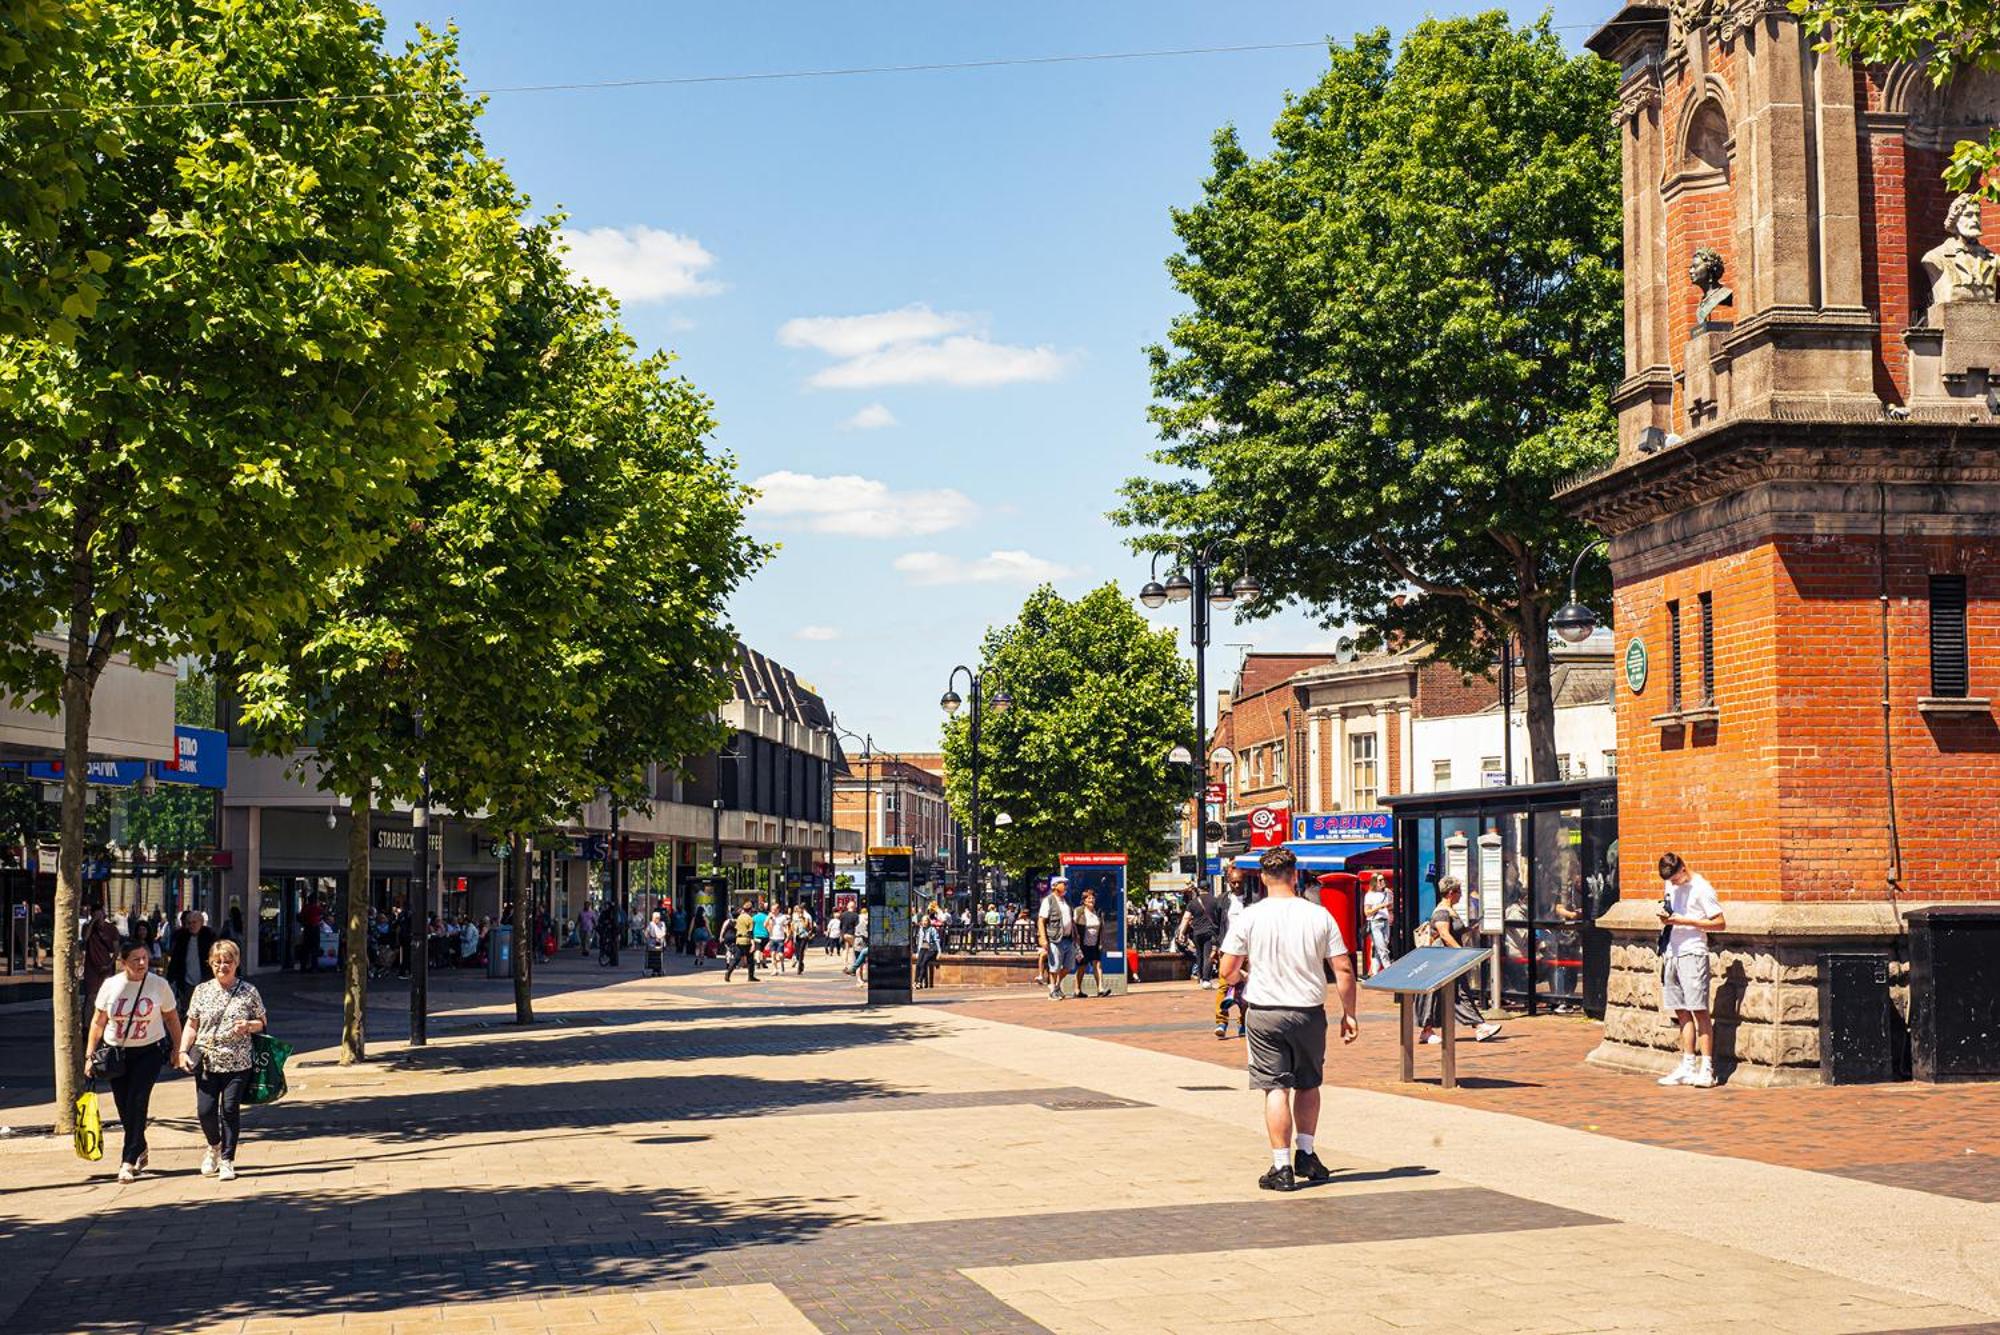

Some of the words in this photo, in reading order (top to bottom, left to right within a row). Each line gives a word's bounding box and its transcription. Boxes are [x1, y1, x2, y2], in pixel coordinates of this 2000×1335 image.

[178, 759, 197, 773] BANK
[1313, 815, 1387, 831] SABINA
[378, 830, 416, 849] STARBUCK
[428, 834, 443, 851] FFEE
